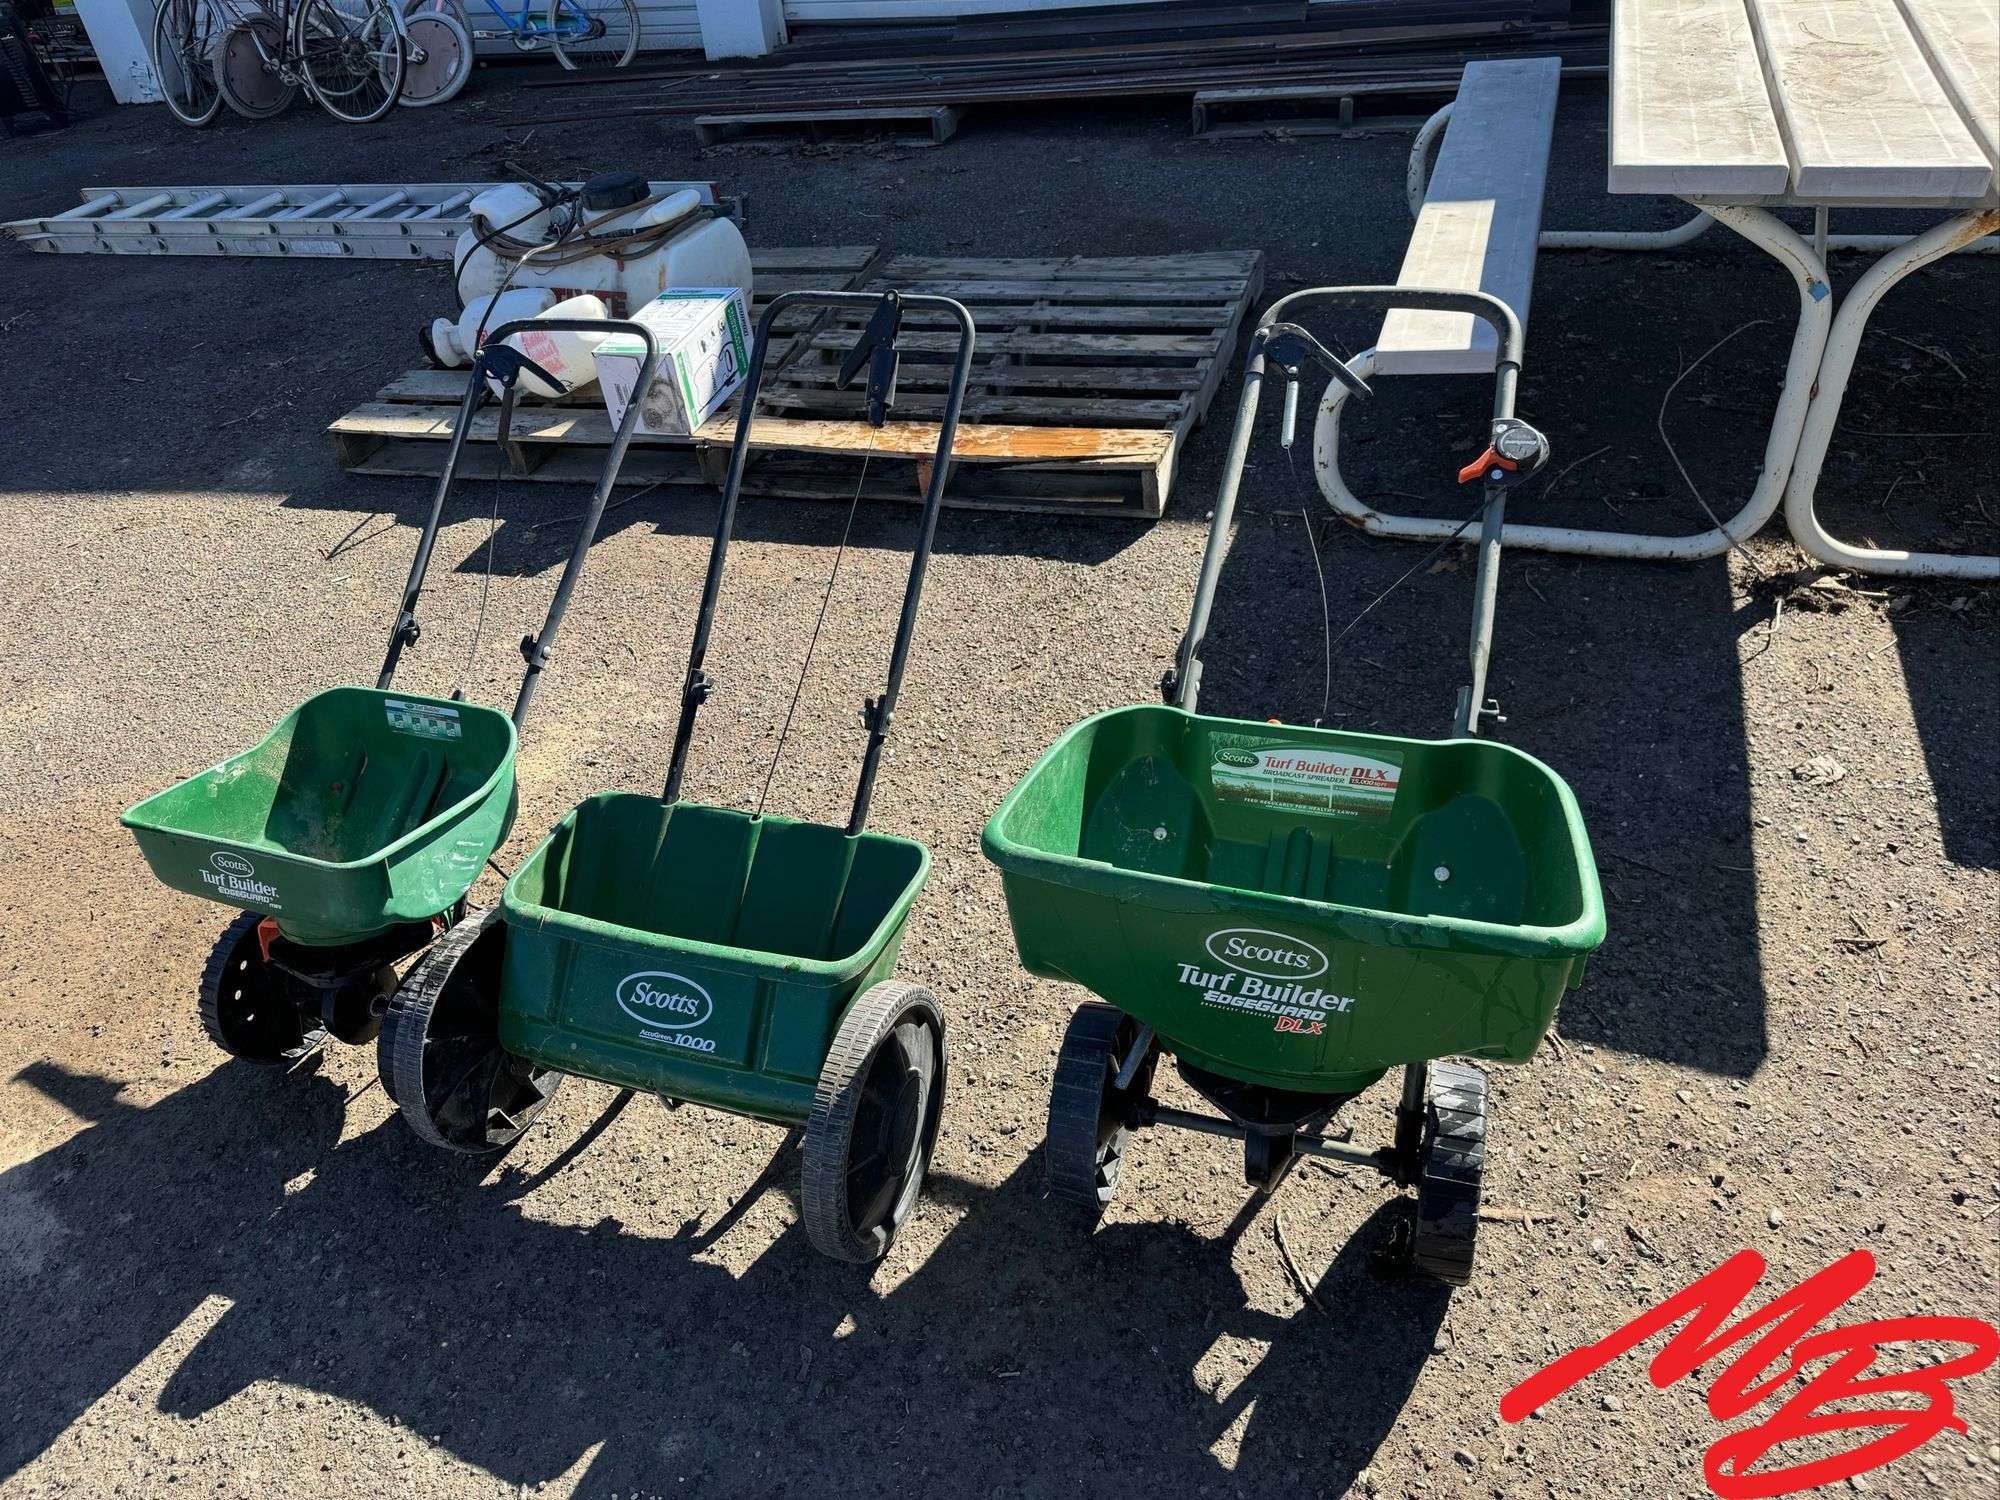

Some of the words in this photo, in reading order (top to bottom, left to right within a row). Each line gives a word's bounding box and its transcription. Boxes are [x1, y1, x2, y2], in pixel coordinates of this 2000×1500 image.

[1221, 750, 1256, 765] Scotts
[1265, 756, 1294, 770] Turf
[1295, 761, 1348, 776] Builder
[1351, 767, 1389, 780] DLX
[1262, 769, 1305, 780] BROADCAST
[1307, 775, 1345, 784] SPREADER
[218, 857, 248, 872] Scotts
[199, 869, 226, 886] Turf
[228, 875, 278, 897] Builder
[1224, 937, 1311, 969] Scotts
[630, 982, 699, 1015] Scotts
[1177, 963, 1236, 991] Turf
[1239, 976, 1355, 1012] Builder
[1203, 990, 1326, 1021] EDGEGUARD
[1274, 1015, 1327, 1035] DLX
[673, 1034, 716, 1052] 1000
